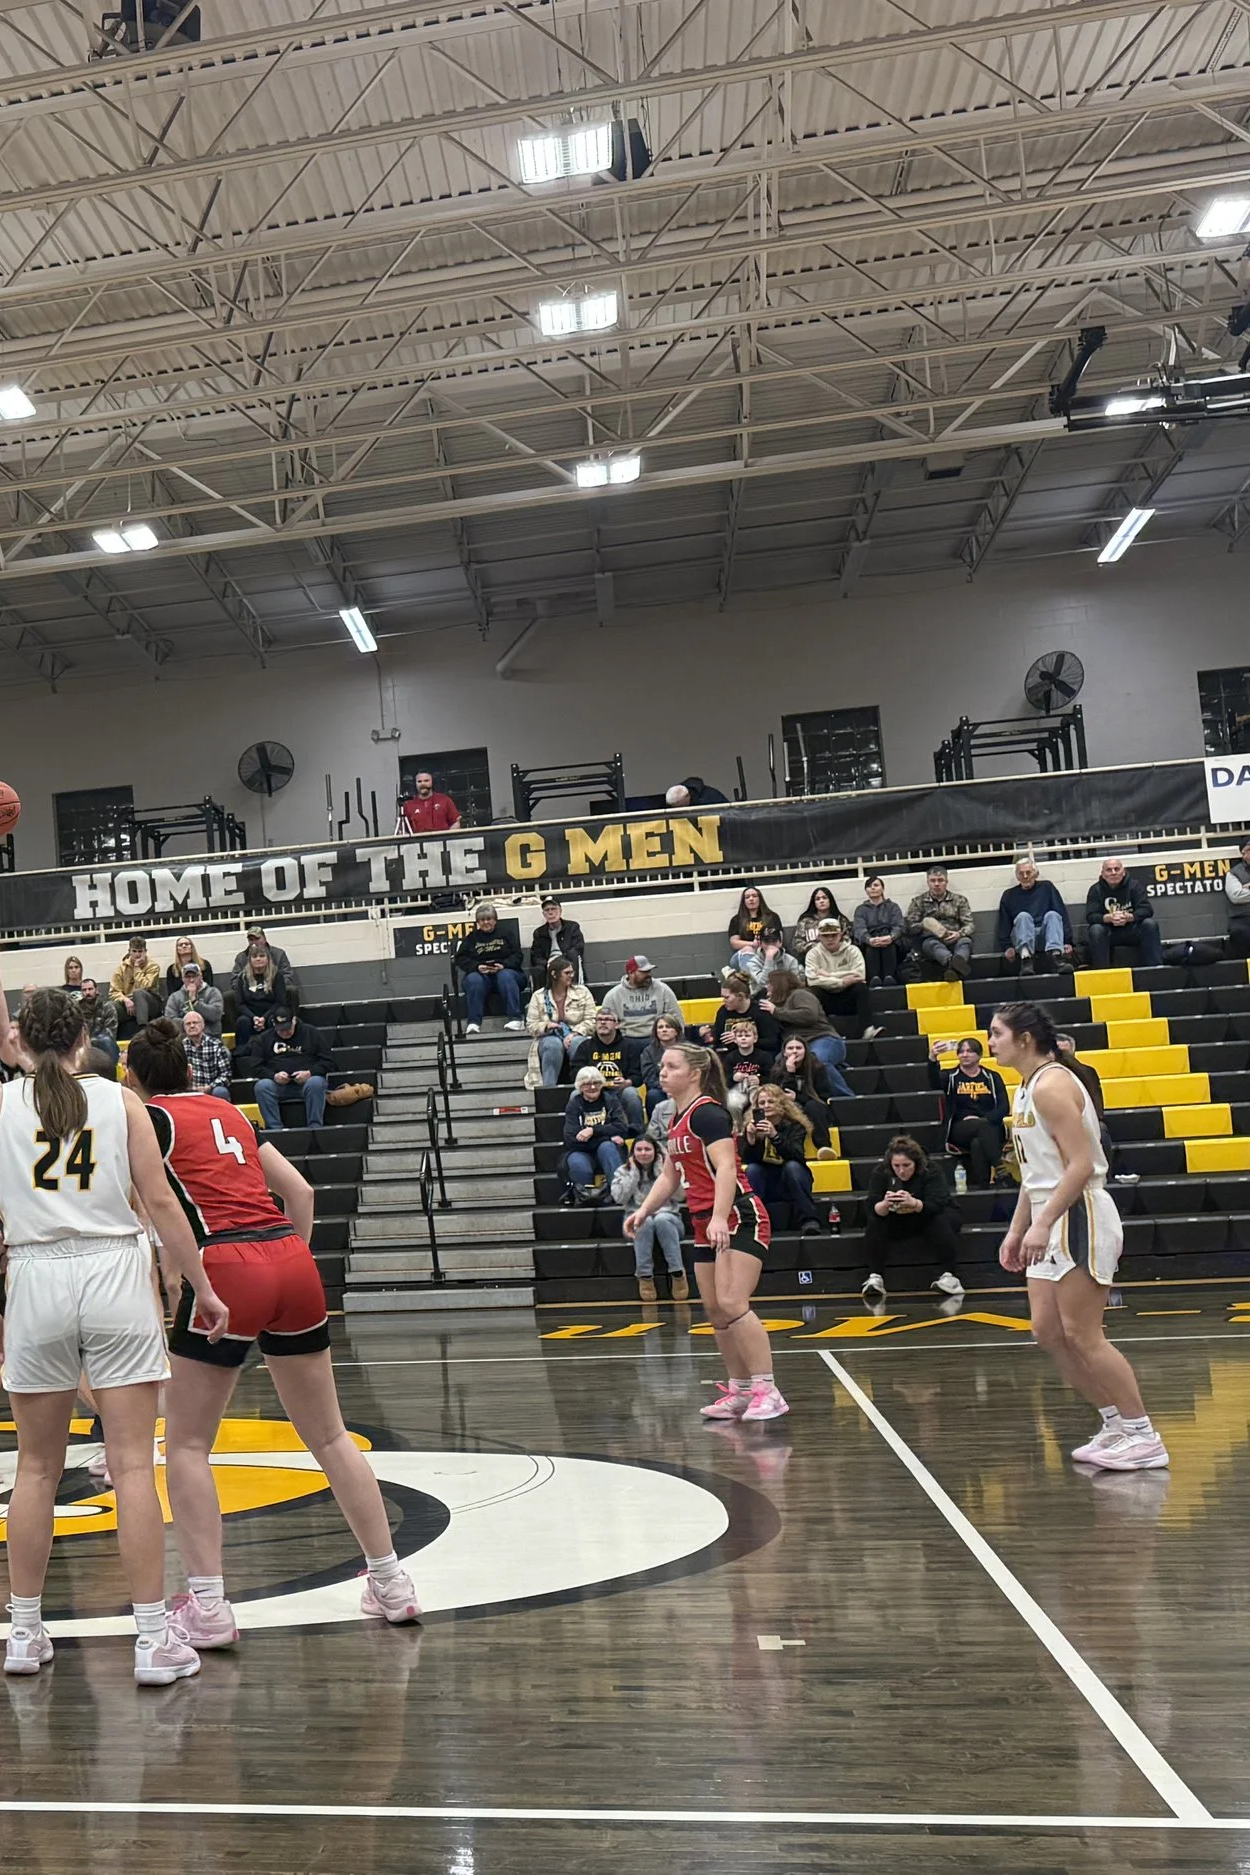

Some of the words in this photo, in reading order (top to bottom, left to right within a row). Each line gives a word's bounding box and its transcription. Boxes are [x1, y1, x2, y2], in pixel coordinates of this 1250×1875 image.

[71, 862, 245, 920] HOME
[261, 851, 338, 903] OF
[355, 836, 488, 893] THE
[504, 832, 547, 880] G
[565, 815, 724, 875] MEN
[1154, 860, 1230, 882] G-MEN
[1146, 879, 1223, 897] SPECTATO
[422, 922, 475, 942] G-ME
[629, 993, 650, 1002] OHIO
[592, 1051, 622, 1061] G-MEN
[210, 1117, 247, 1165] 4
[32, 1127, 98, 1192] 24
